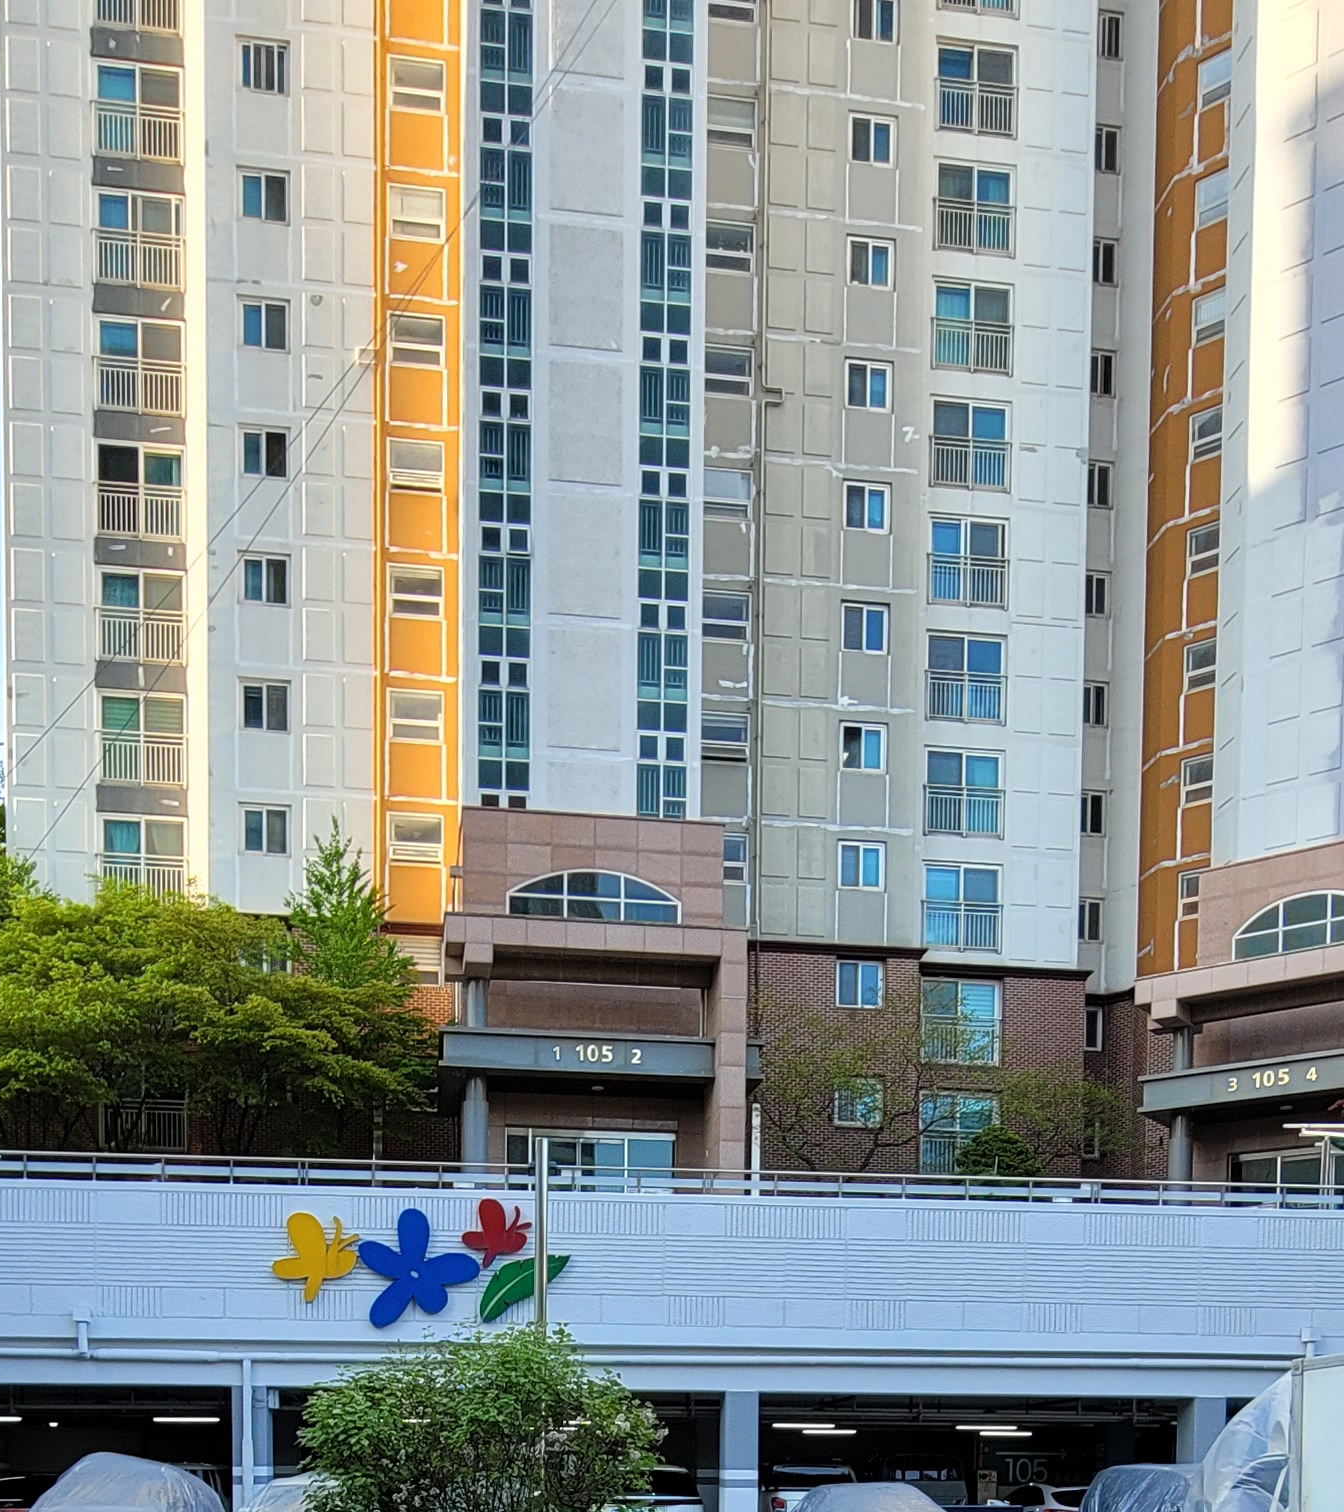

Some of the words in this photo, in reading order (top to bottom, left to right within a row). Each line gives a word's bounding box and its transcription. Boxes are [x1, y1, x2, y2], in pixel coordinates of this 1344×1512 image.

[552, 1045, 561, 1061] 1
[575, 1044, 614, 1063] 105
[630, 1048, 643, 1064] 2
[1227, 1077, 1239, 1092] 3
[1252, 1068, 1291, 1089] 105
[1305, 1066, 1318, 1082] 4
[1004, 1458, 1049, 1483] 105
